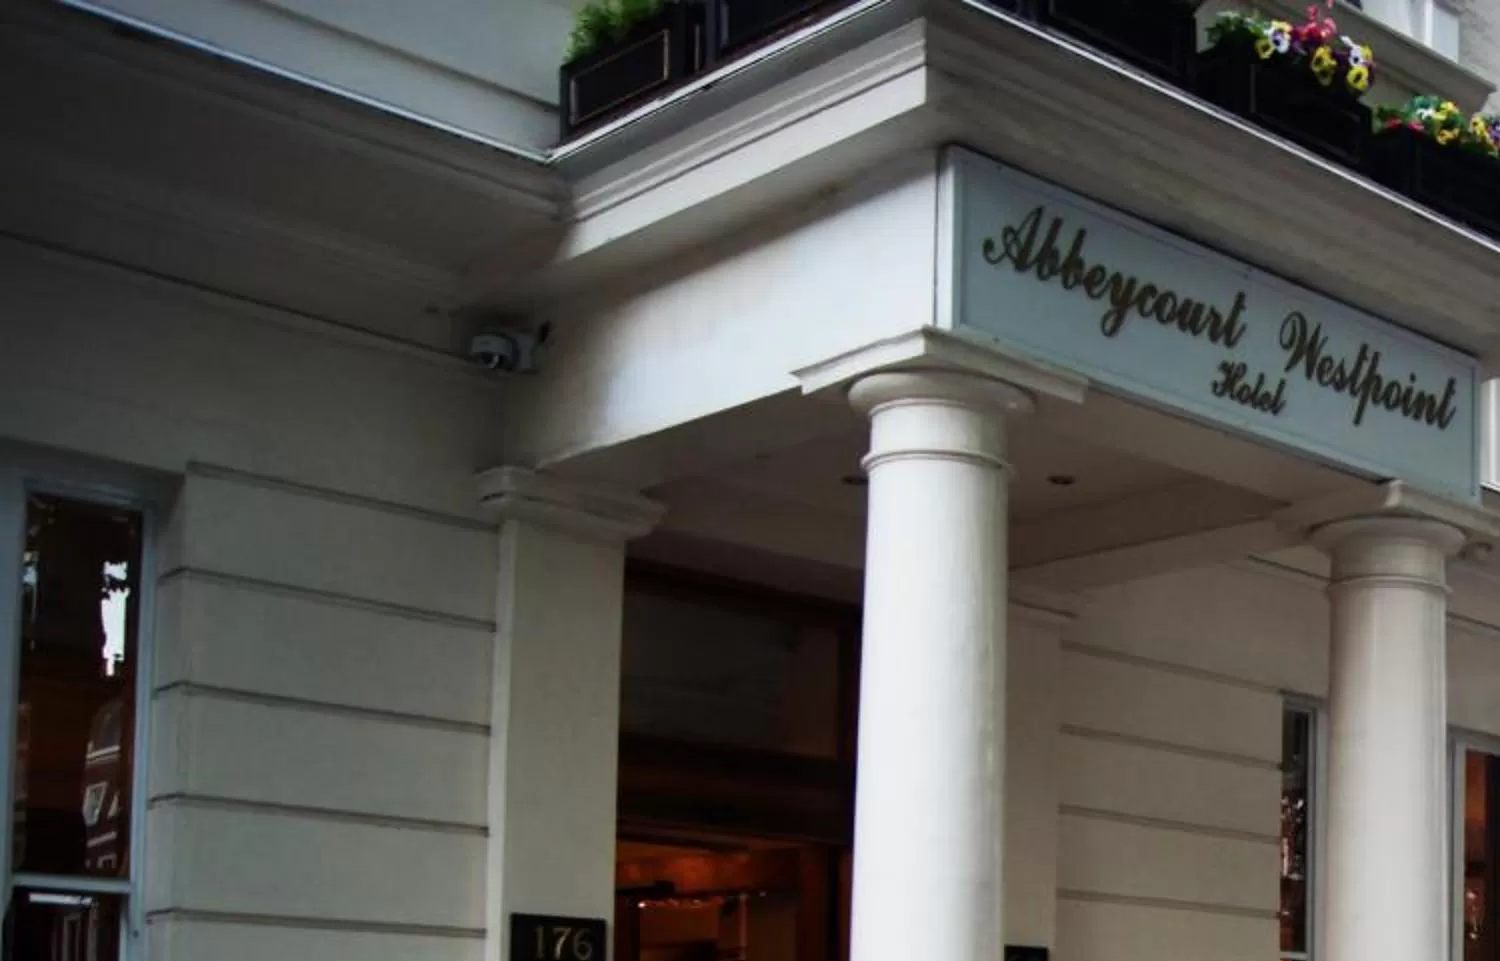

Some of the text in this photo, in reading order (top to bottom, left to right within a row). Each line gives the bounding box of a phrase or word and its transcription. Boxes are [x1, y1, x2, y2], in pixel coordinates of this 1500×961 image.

[982, 205, 1458, 430] Abbeycourt Westpoint
[1212, 360, 1287, 417] Hotel
[534, 924, 594, 961] 176
